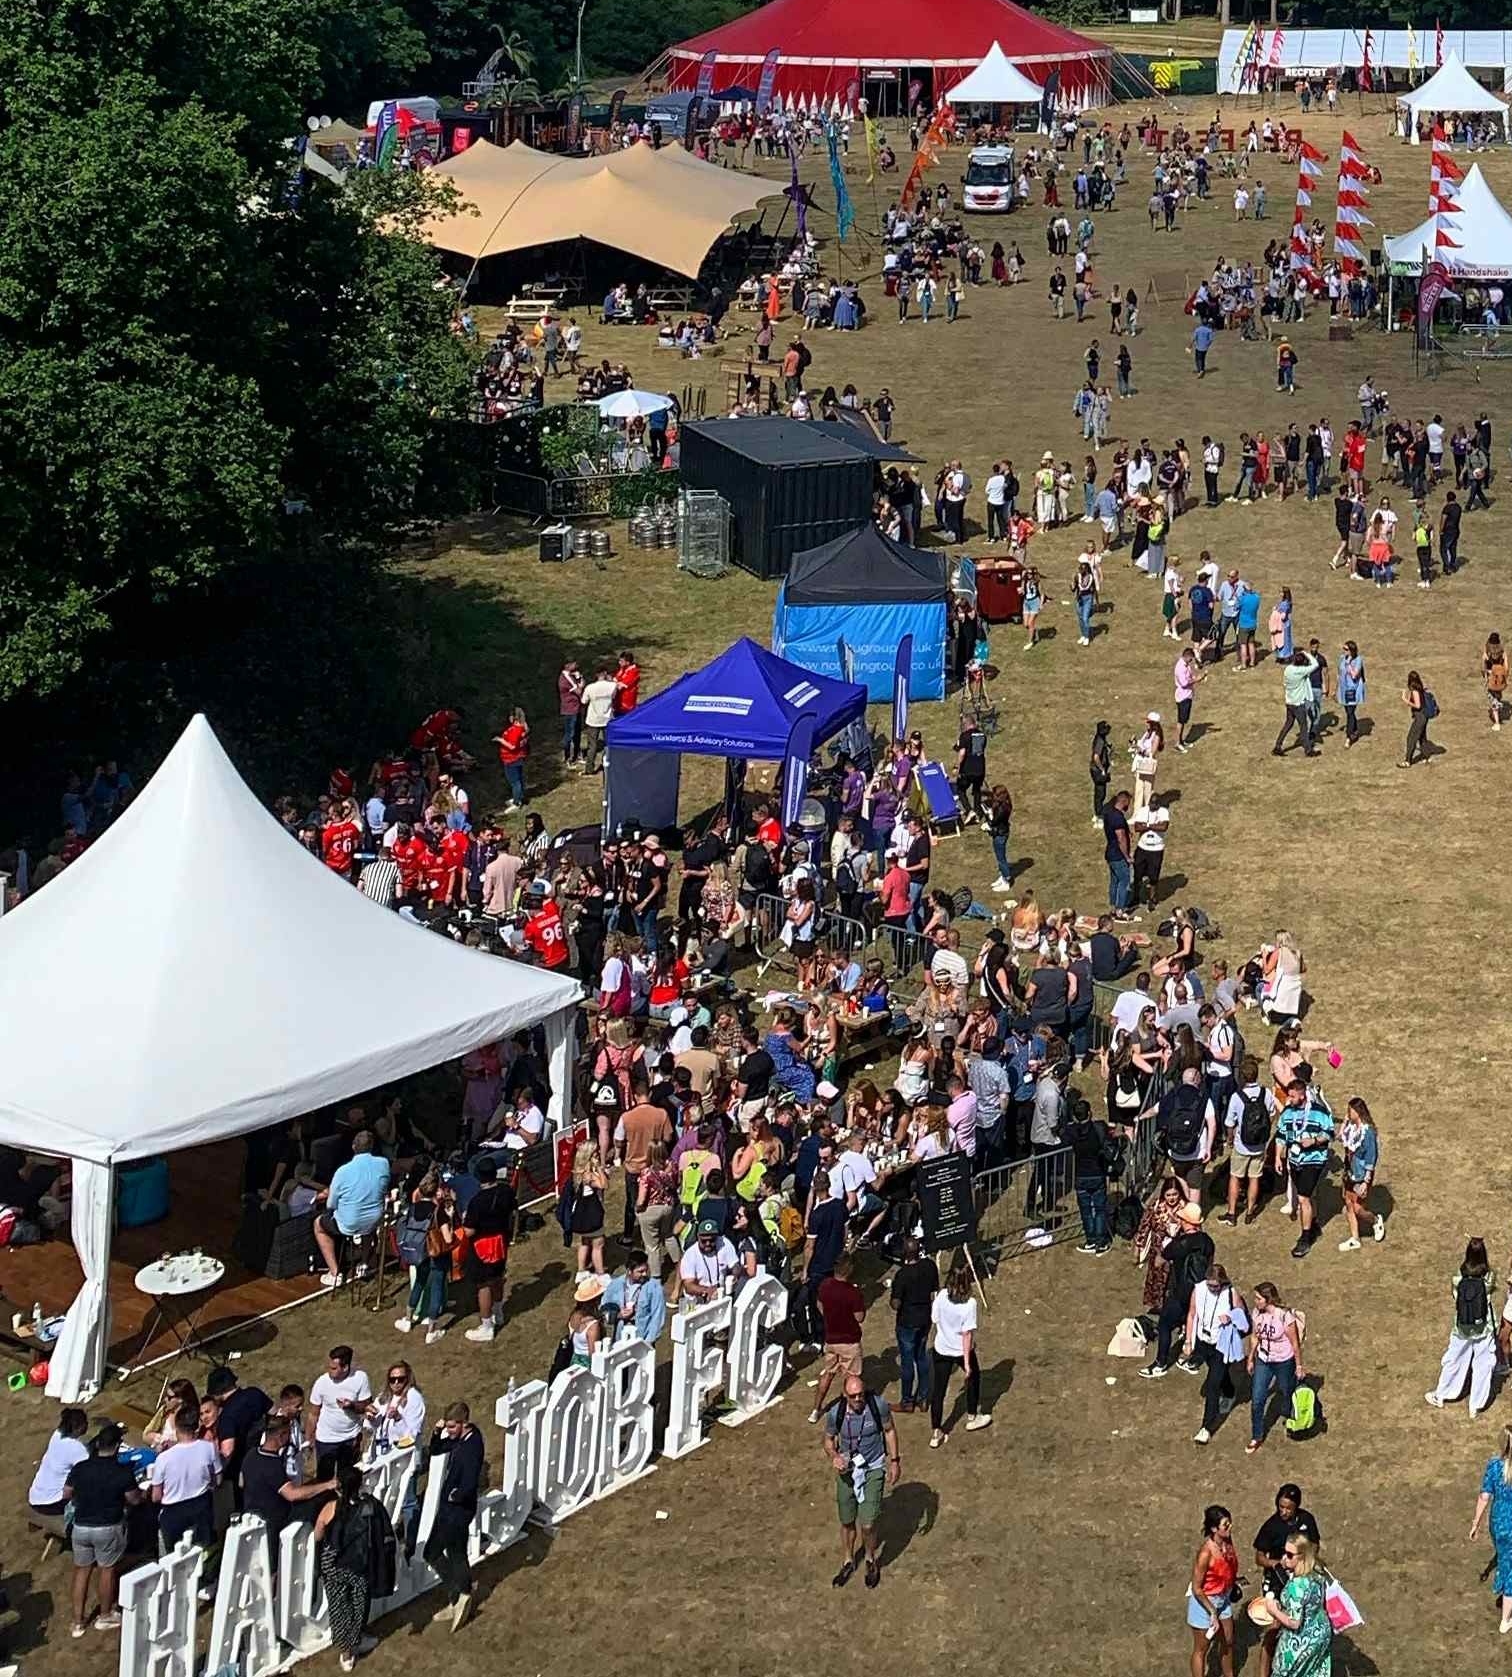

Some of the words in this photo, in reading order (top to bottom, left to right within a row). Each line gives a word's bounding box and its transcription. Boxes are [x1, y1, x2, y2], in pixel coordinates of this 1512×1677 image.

[1285, 67, 1328, 77] RECFEST
[1457, 267, 1509, 277] Handshake
[693, 735, 723, 748] Advisory
[723, 737, 755, 750] Solutions
[541, 921, 564, 947] 96
[663, 1271, 789, 1460] FC
